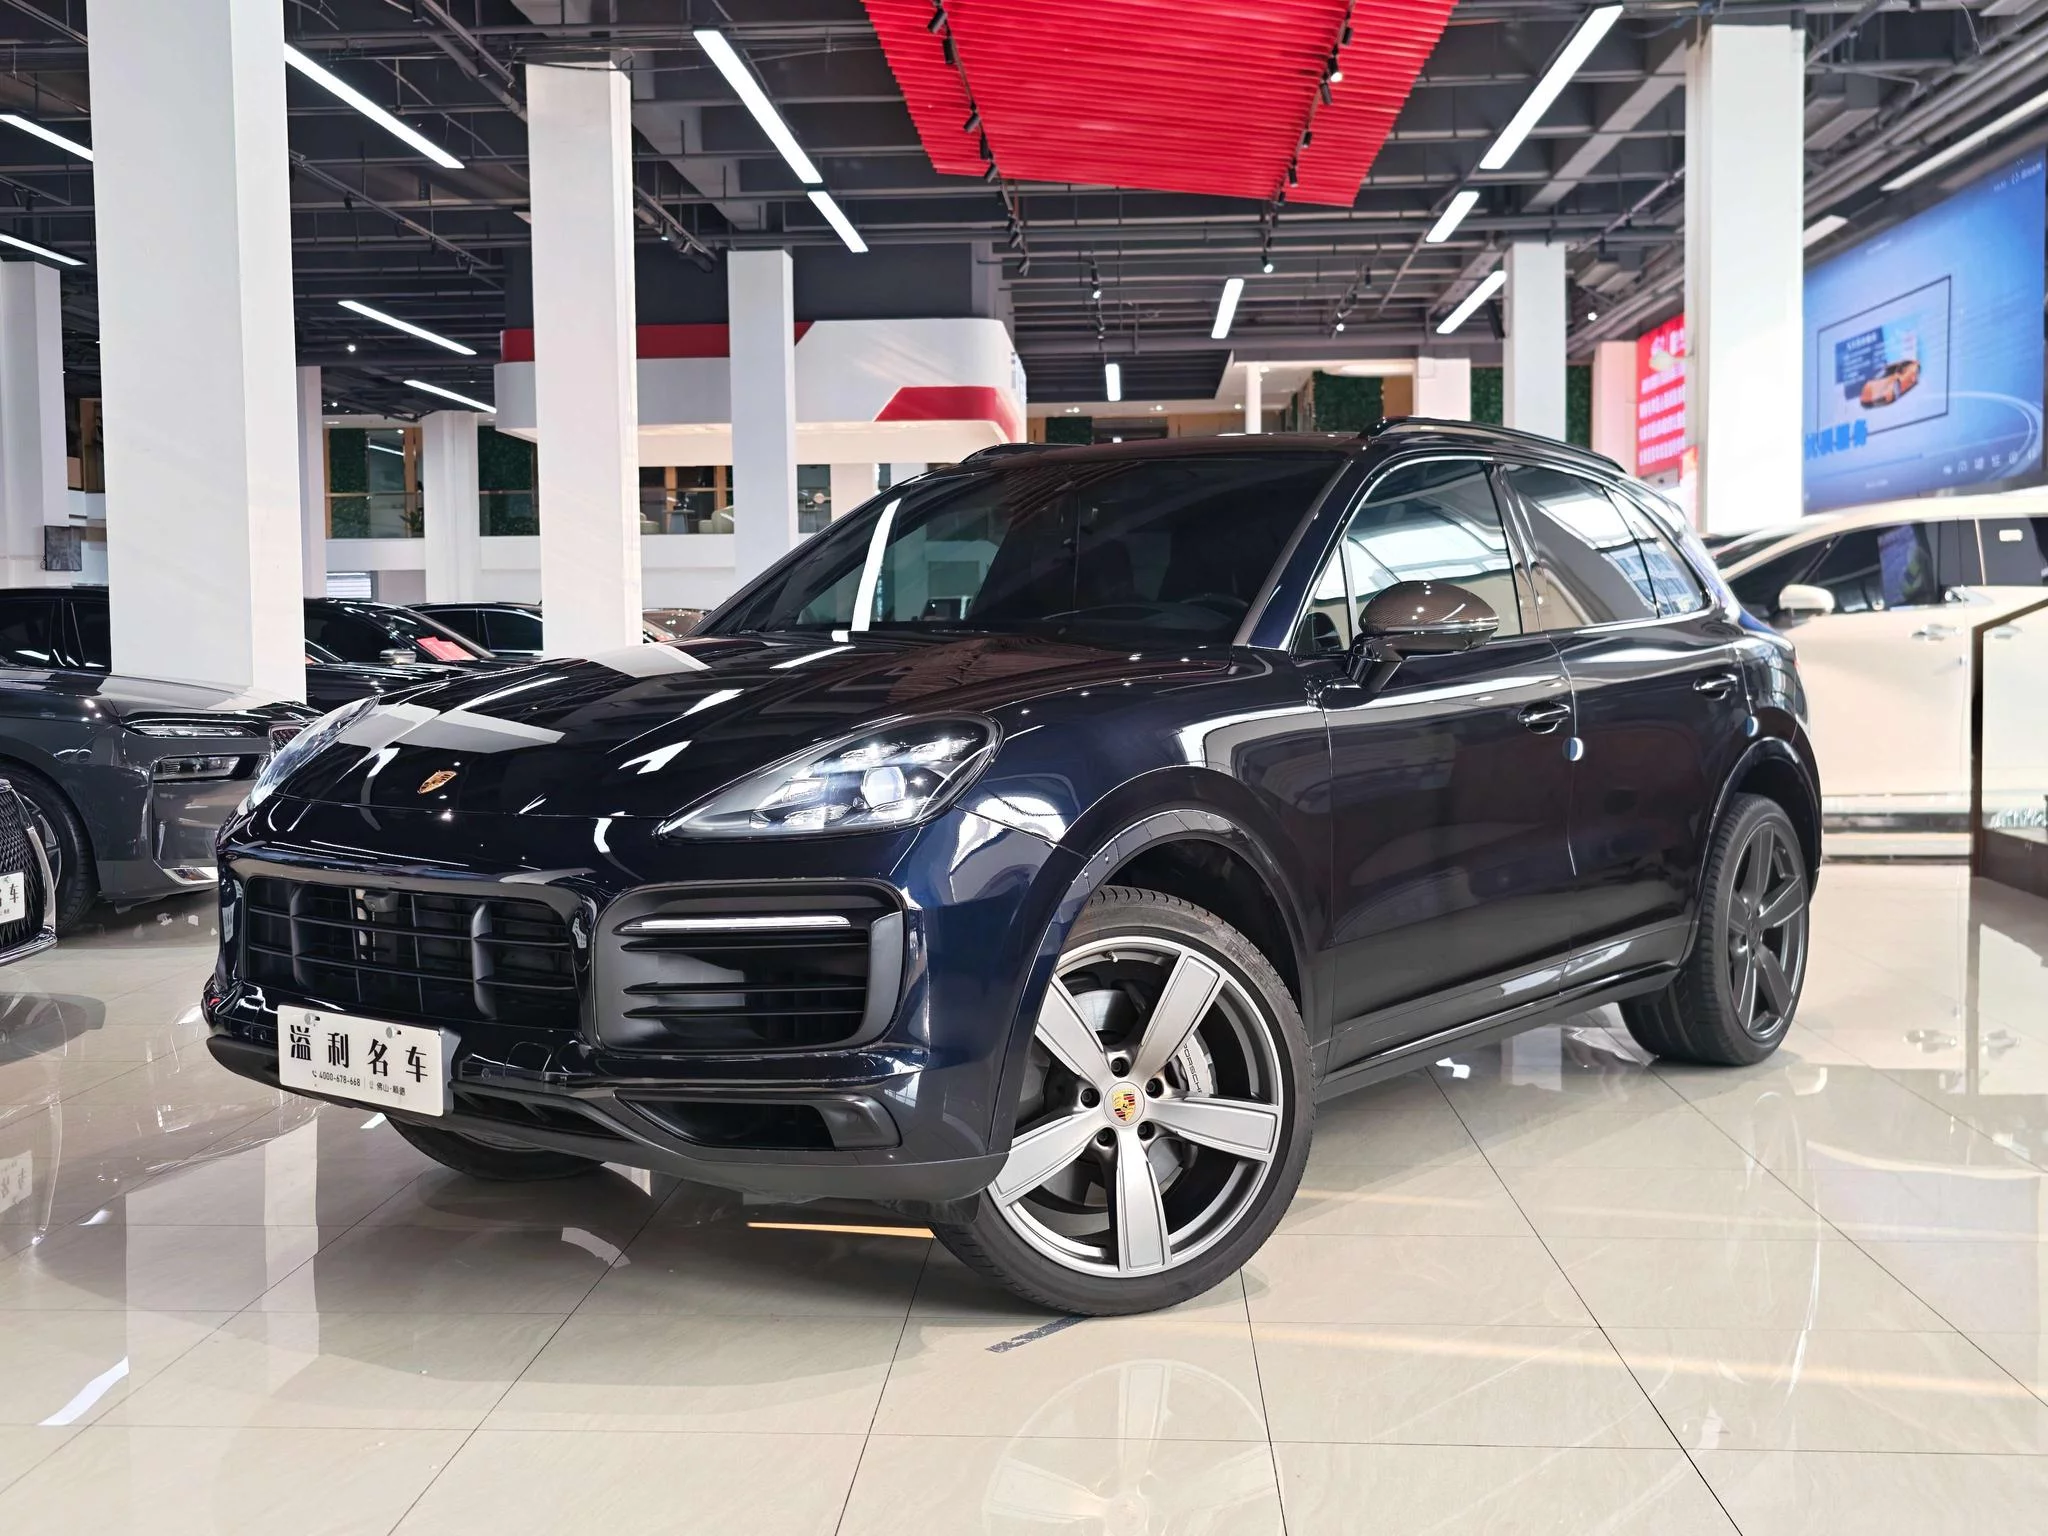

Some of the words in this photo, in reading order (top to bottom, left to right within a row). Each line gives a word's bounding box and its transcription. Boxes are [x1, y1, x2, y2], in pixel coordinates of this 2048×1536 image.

[290, 1024, 428, 1083] 溢利名车
[319, 1071, 361, 1087] 4000-678-668
